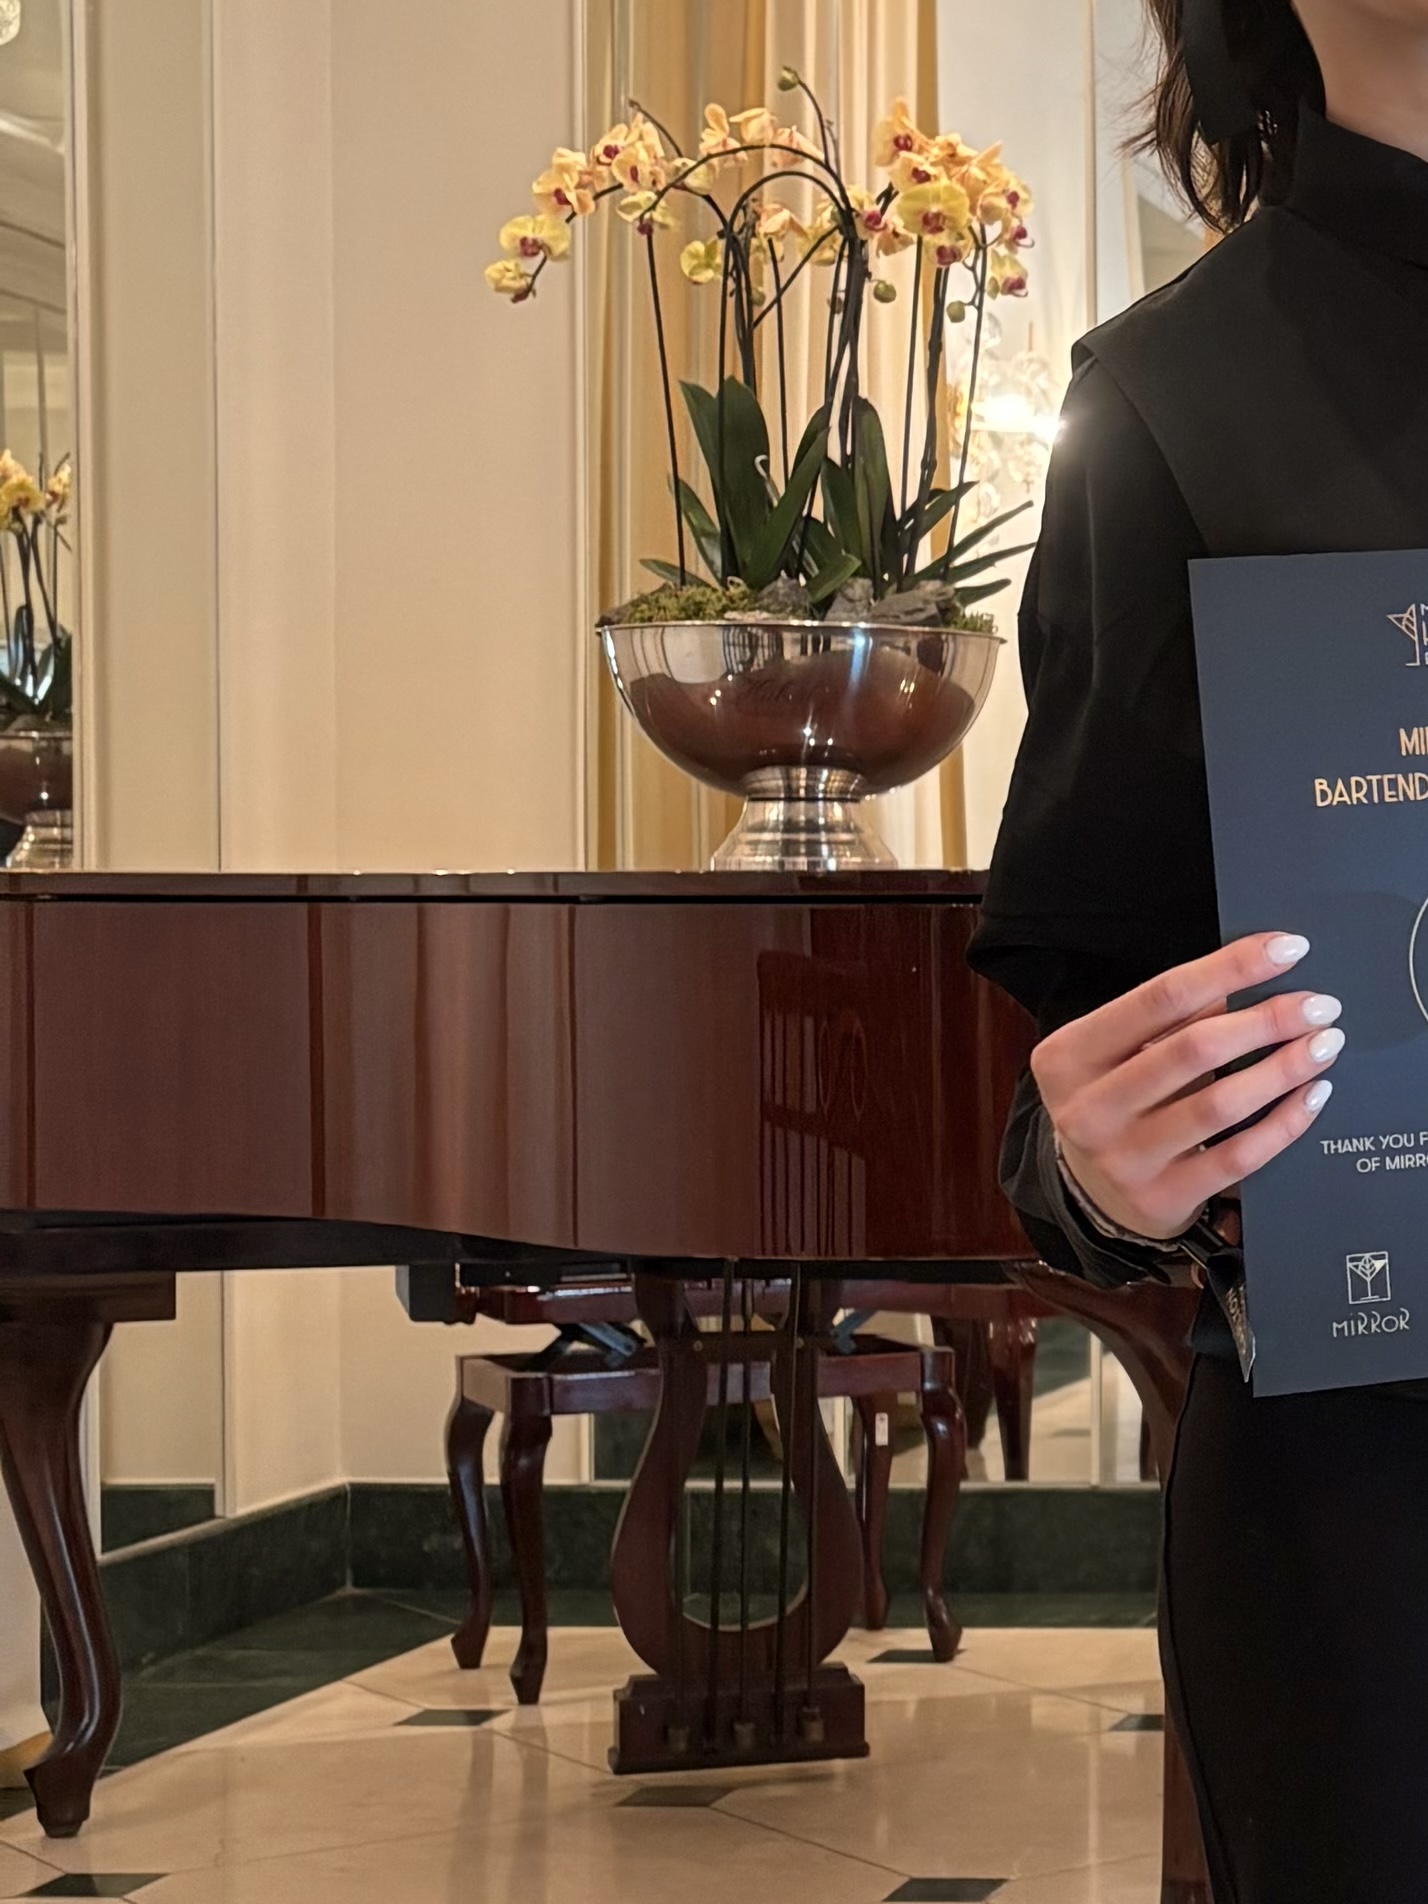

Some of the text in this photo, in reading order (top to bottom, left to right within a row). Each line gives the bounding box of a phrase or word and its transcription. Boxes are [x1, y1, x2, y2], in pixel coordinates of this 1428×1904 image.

[1320, 1135, 1376, 1155] THANK
[1379, 1133, 1415, 1150] YOU
[1356, 1157, 1381, 1174] OF
